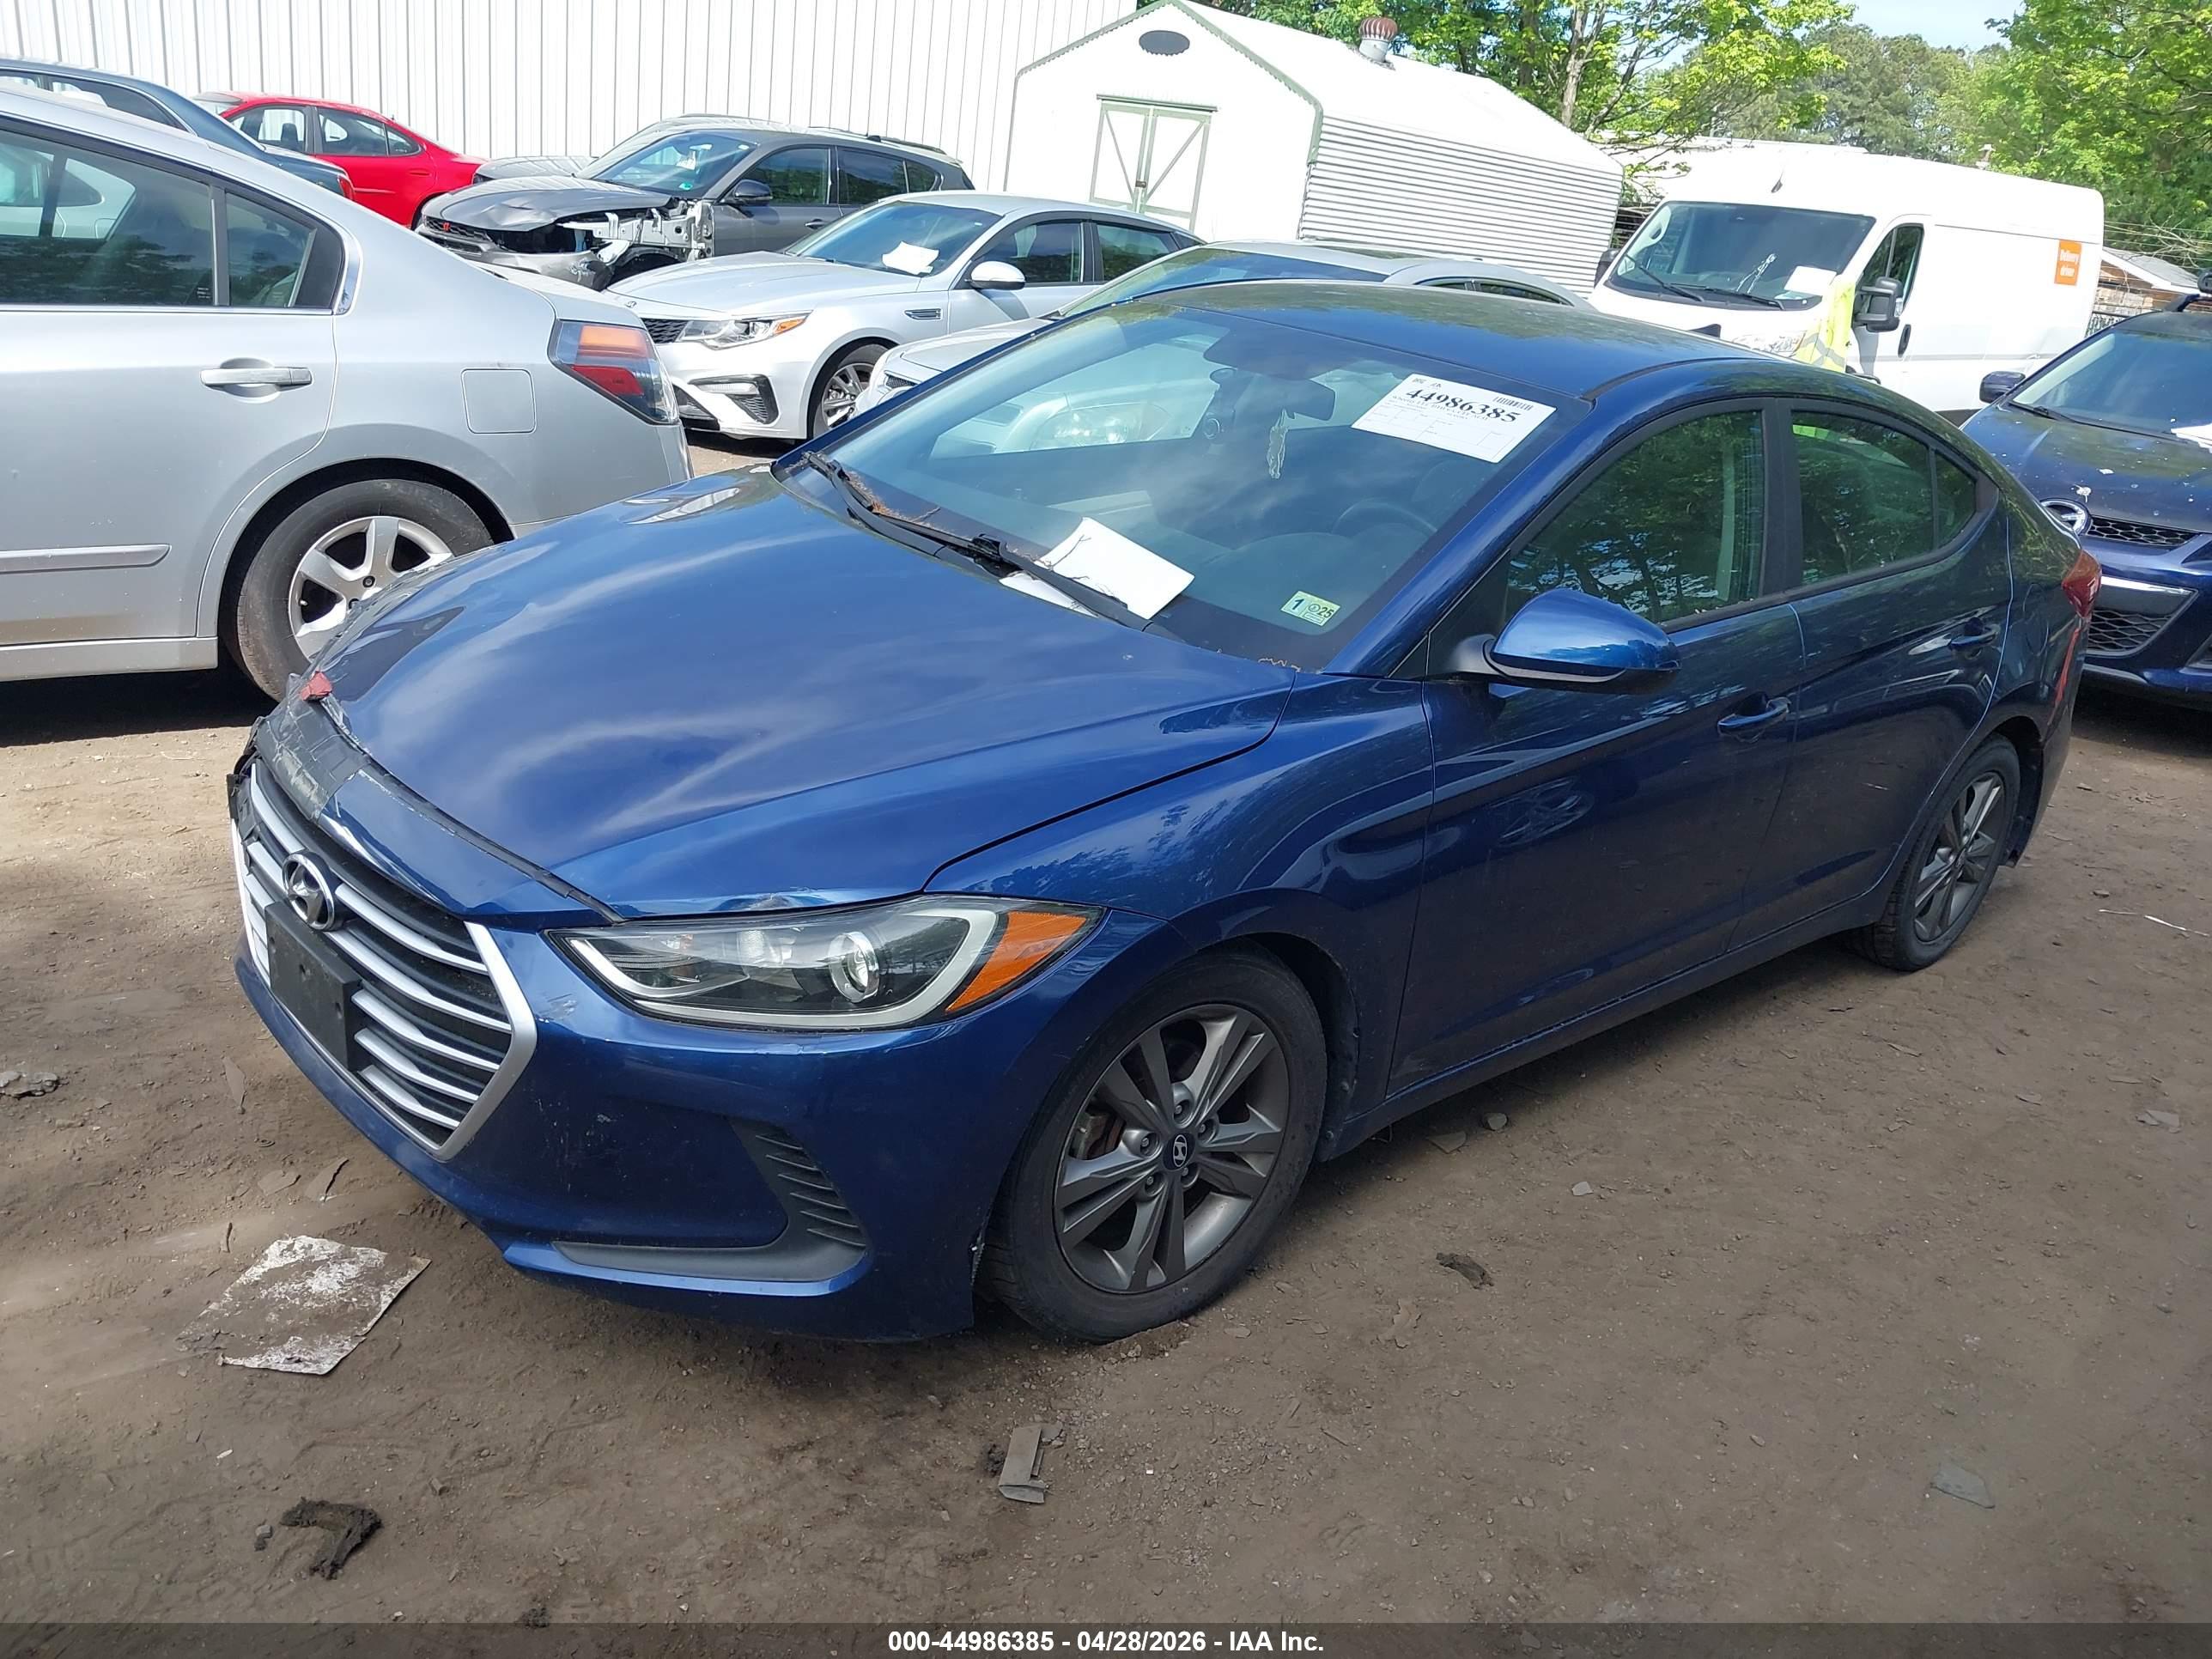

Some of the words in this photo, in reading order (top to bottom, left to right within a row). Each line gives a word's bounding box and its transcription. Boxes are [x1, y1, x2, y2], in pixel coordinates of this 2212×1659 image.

[1406, 389, 1521, 422] 44986385
[1292, 599, 1304, 611] 1
[1316, 606, 1334, 618] 25
